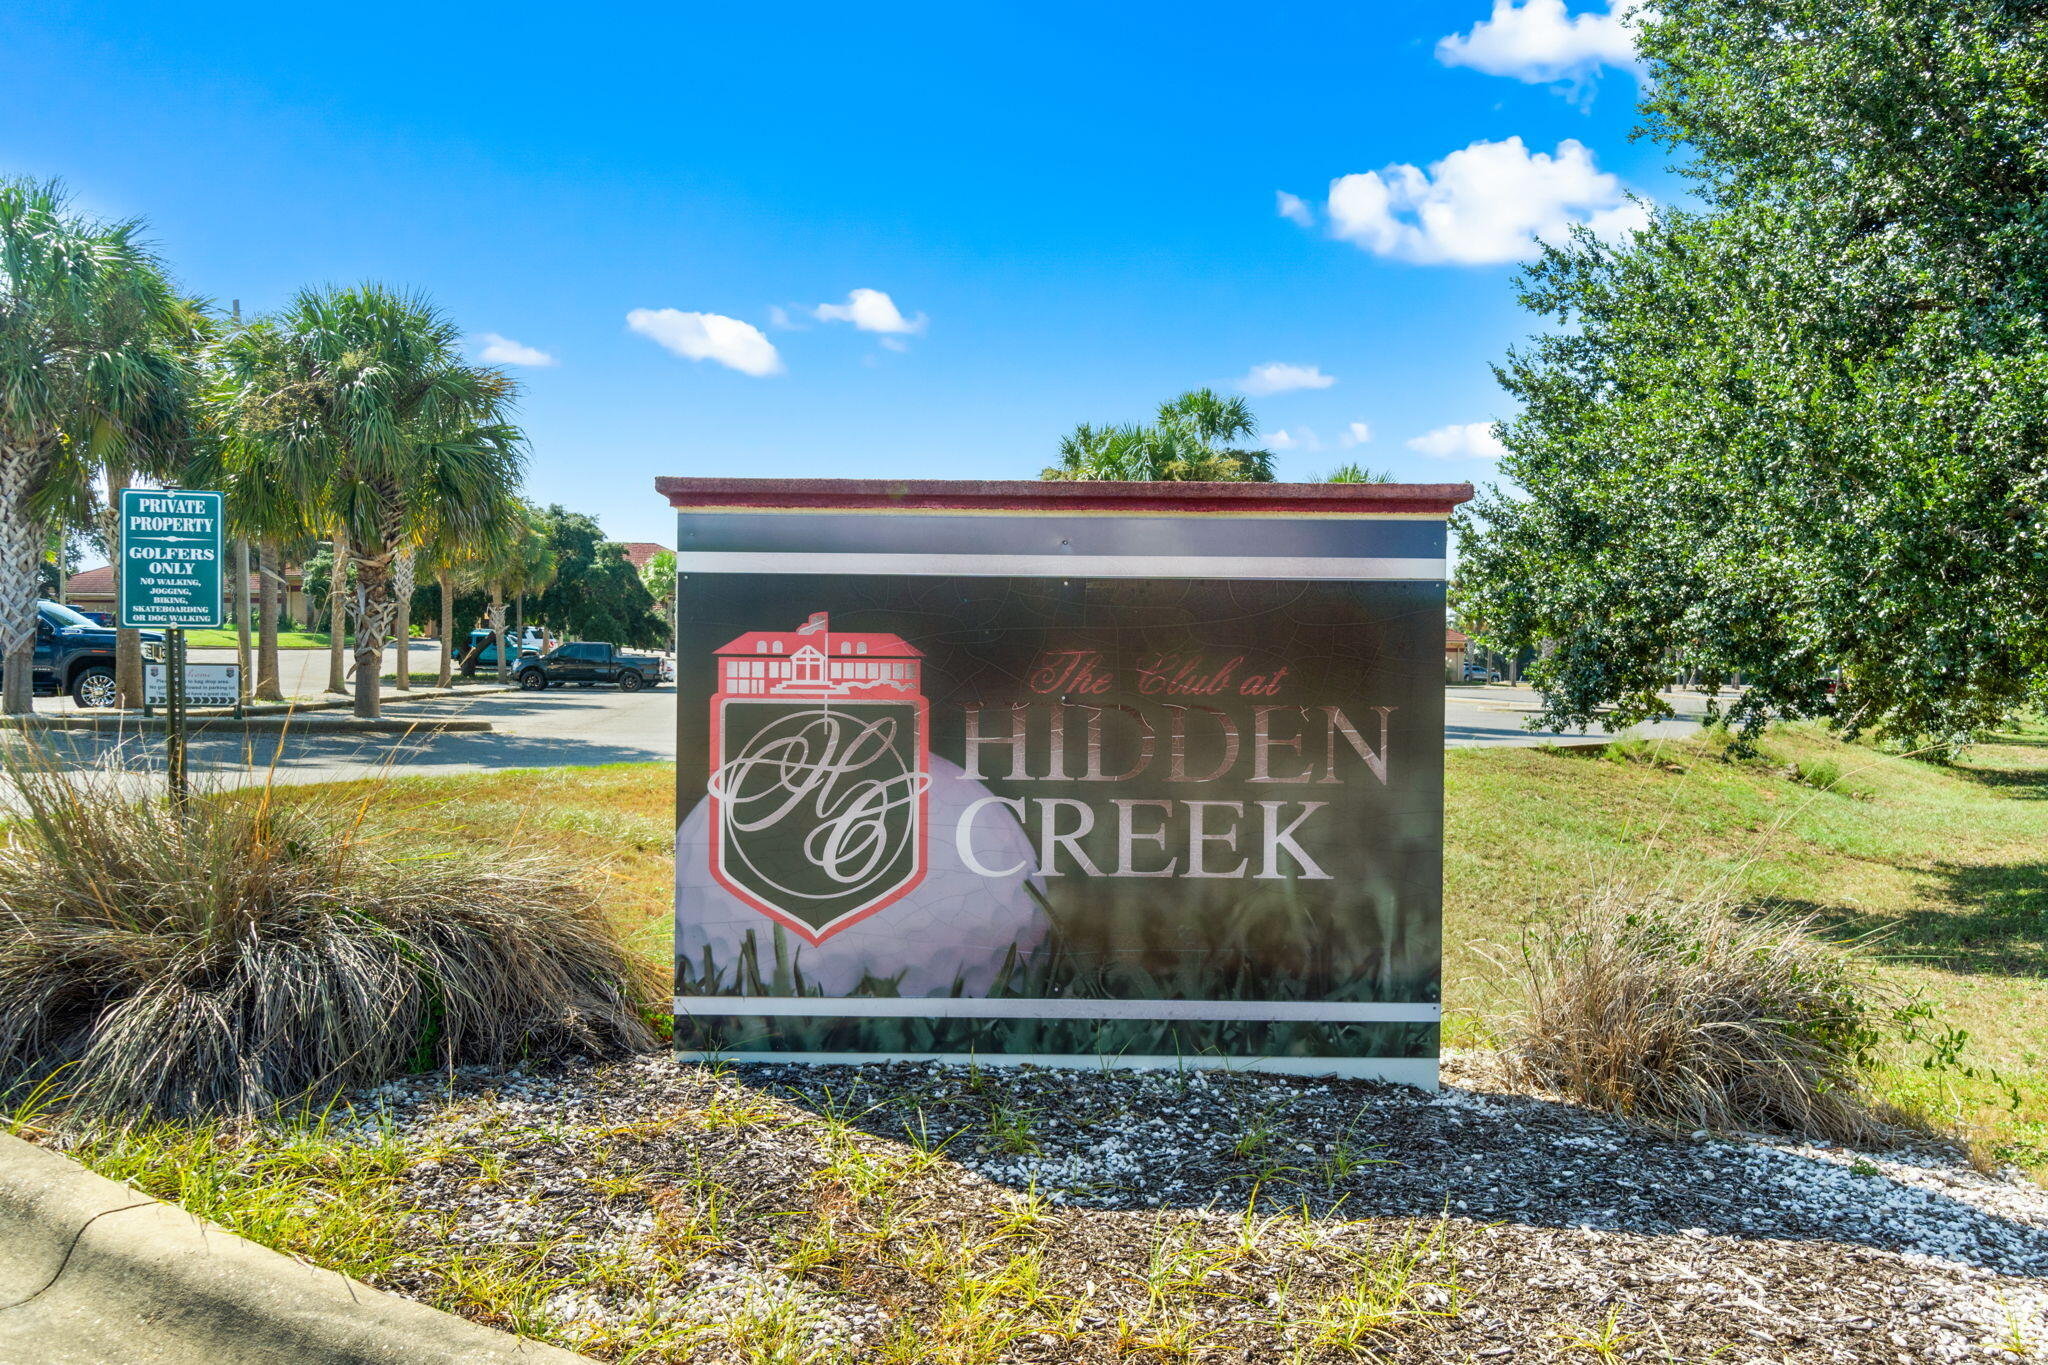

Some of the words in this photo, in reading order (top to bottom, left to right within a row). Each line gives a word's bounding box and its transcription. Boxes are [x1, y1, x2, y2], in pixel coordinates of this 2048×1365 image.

[139, 498, 206, 514] PRIVATE
[130, 516, 214, 533] PROPERTY
[129, 546, 215, 561] GOLFERS
[149, 562, 196, 575] ONLY
[140, 577, 155, 585] NO
[156, 578, 201, 587] WALKING,
[149, 587, 192, 596] JOGGING,
[153, 596, 189, 605] BIKING,
[132, 605, 209, 614] SKATEBOARDING
[132, 614, 146, 622] OR
[148, 614, 167, 622] DOG
[169, 615, 211, 623] WALKING
[1030, 650, 1115, 695] The
[1135, 652, 1246, 696] Club
[1239, 666, 1289, 697] at
[956, 702, 1399, 786] HIDDEN
[955, 795, 1335, 880] CREEK
